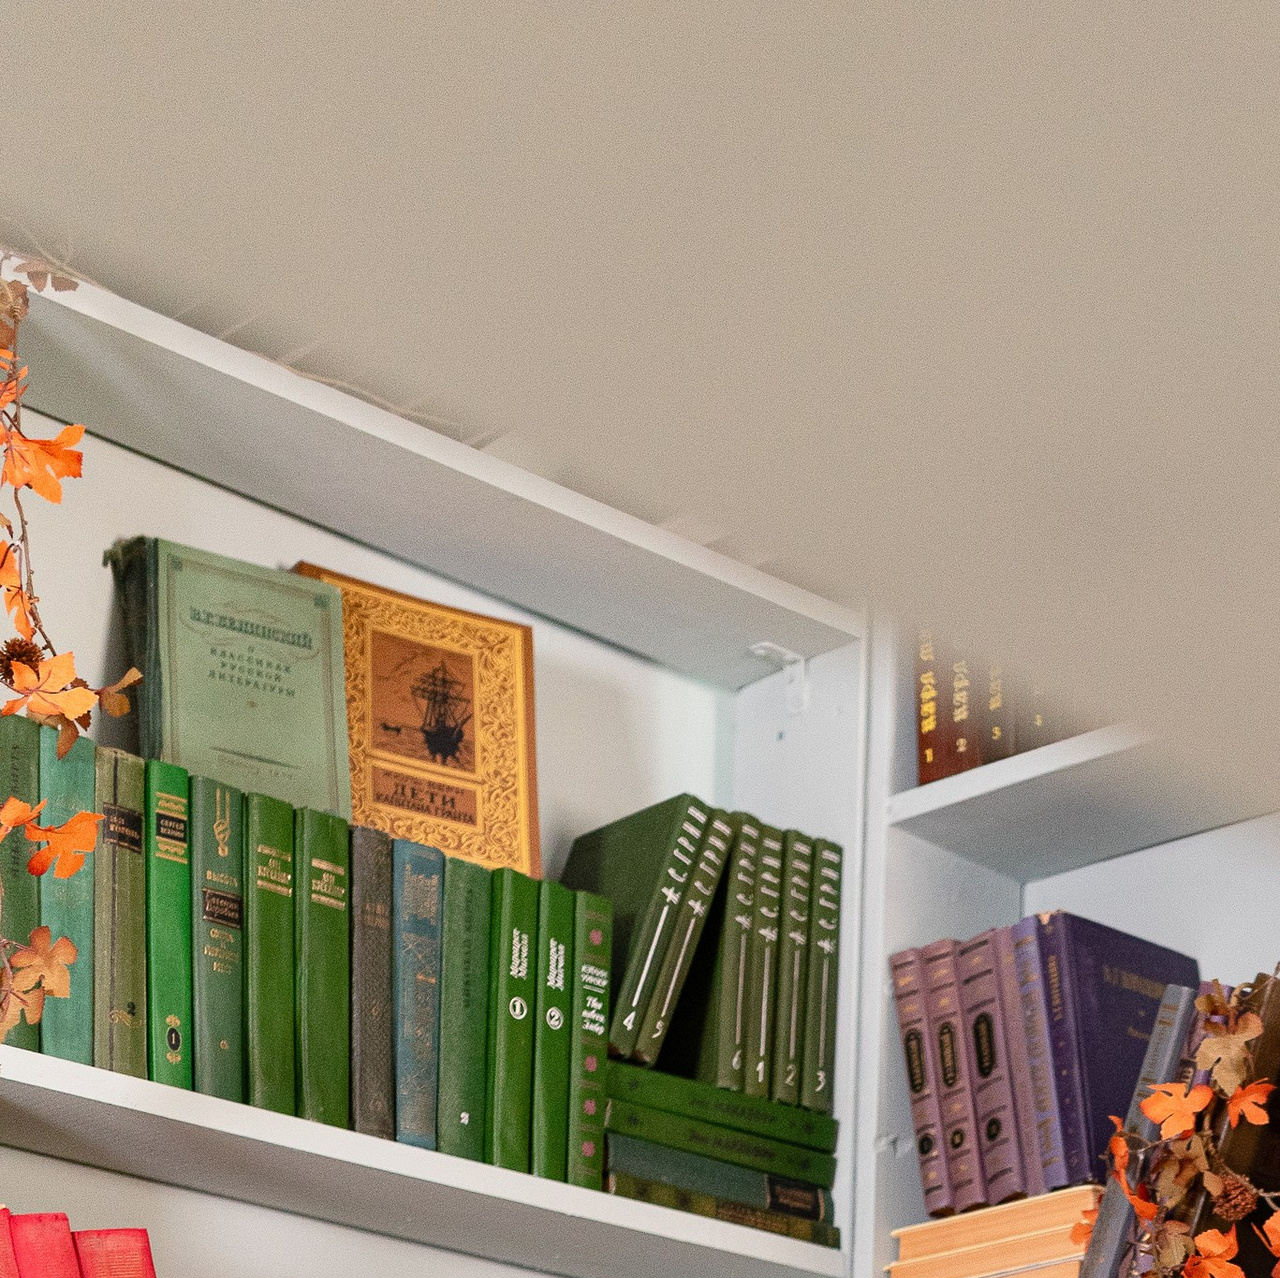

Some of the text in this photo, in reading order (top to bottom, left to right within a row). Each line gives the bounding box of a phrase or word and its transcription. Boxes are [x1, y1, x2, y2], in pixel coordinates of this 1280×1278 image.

[956, 737, 967, 752] 2
[394, 783, 456, 809] ДЕТИ
[673, 805, 707, 865] ГРИН
[699, 818, 733, 879] ГРИН
[737, 823, 760, 886] ГРИН
[760, 837, 783, 899] ГРИН
[790, 841, 812, 902] ГРИН
[819, 849, 841, 911] ГРИН
[127, 1003, 137, 1016] 2
[622, 1011, 636, 1032] 4
[652, 1019, 664, 1039] 5
[732, 1050, 742, 1071] 6
[755, 1061, 765, 1083] 1
[785, 1063, 797, 1087] 2
[815, 1070, 827, 1093] 3
